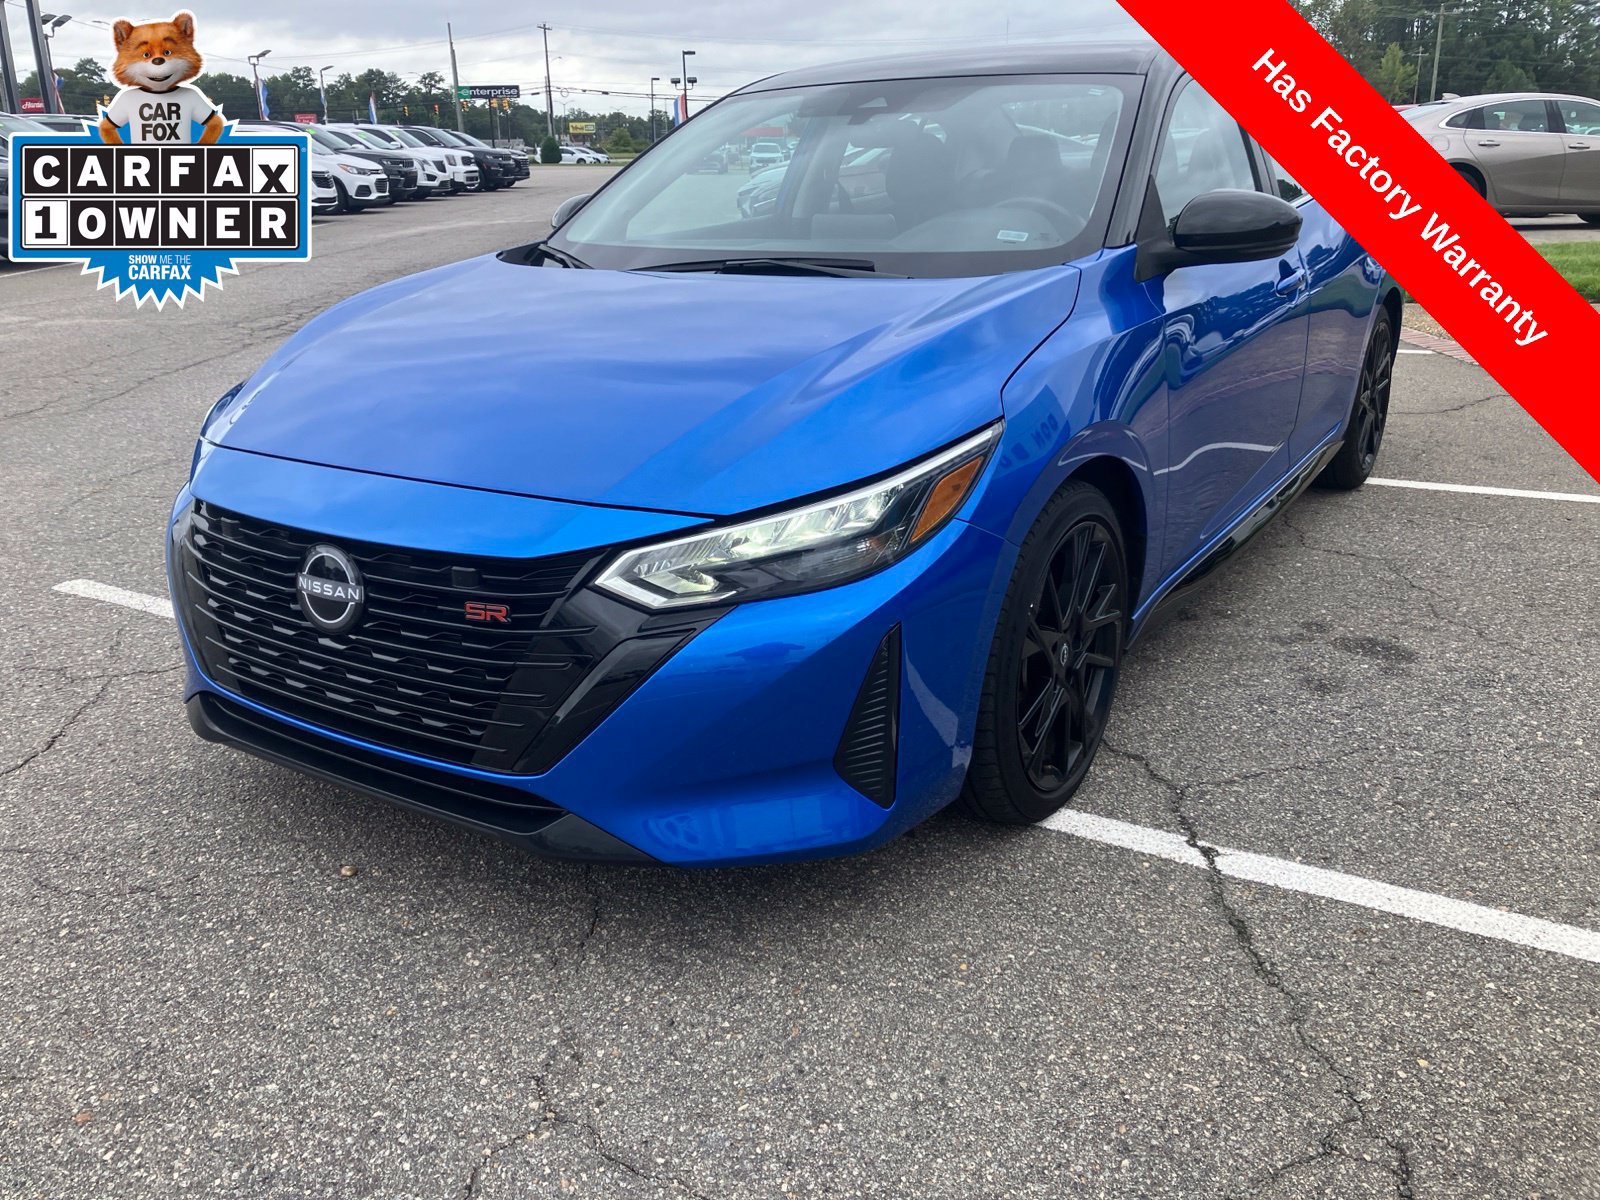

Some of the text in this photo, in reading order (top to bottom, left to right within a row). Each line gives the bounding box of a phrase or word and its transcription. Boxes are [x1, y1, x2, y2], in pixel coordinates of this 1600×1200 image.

[458, 87, 518, 97] enterprise
[299, 576, 360, 600] NISSAN
[464, 601, 511, 623] SR
